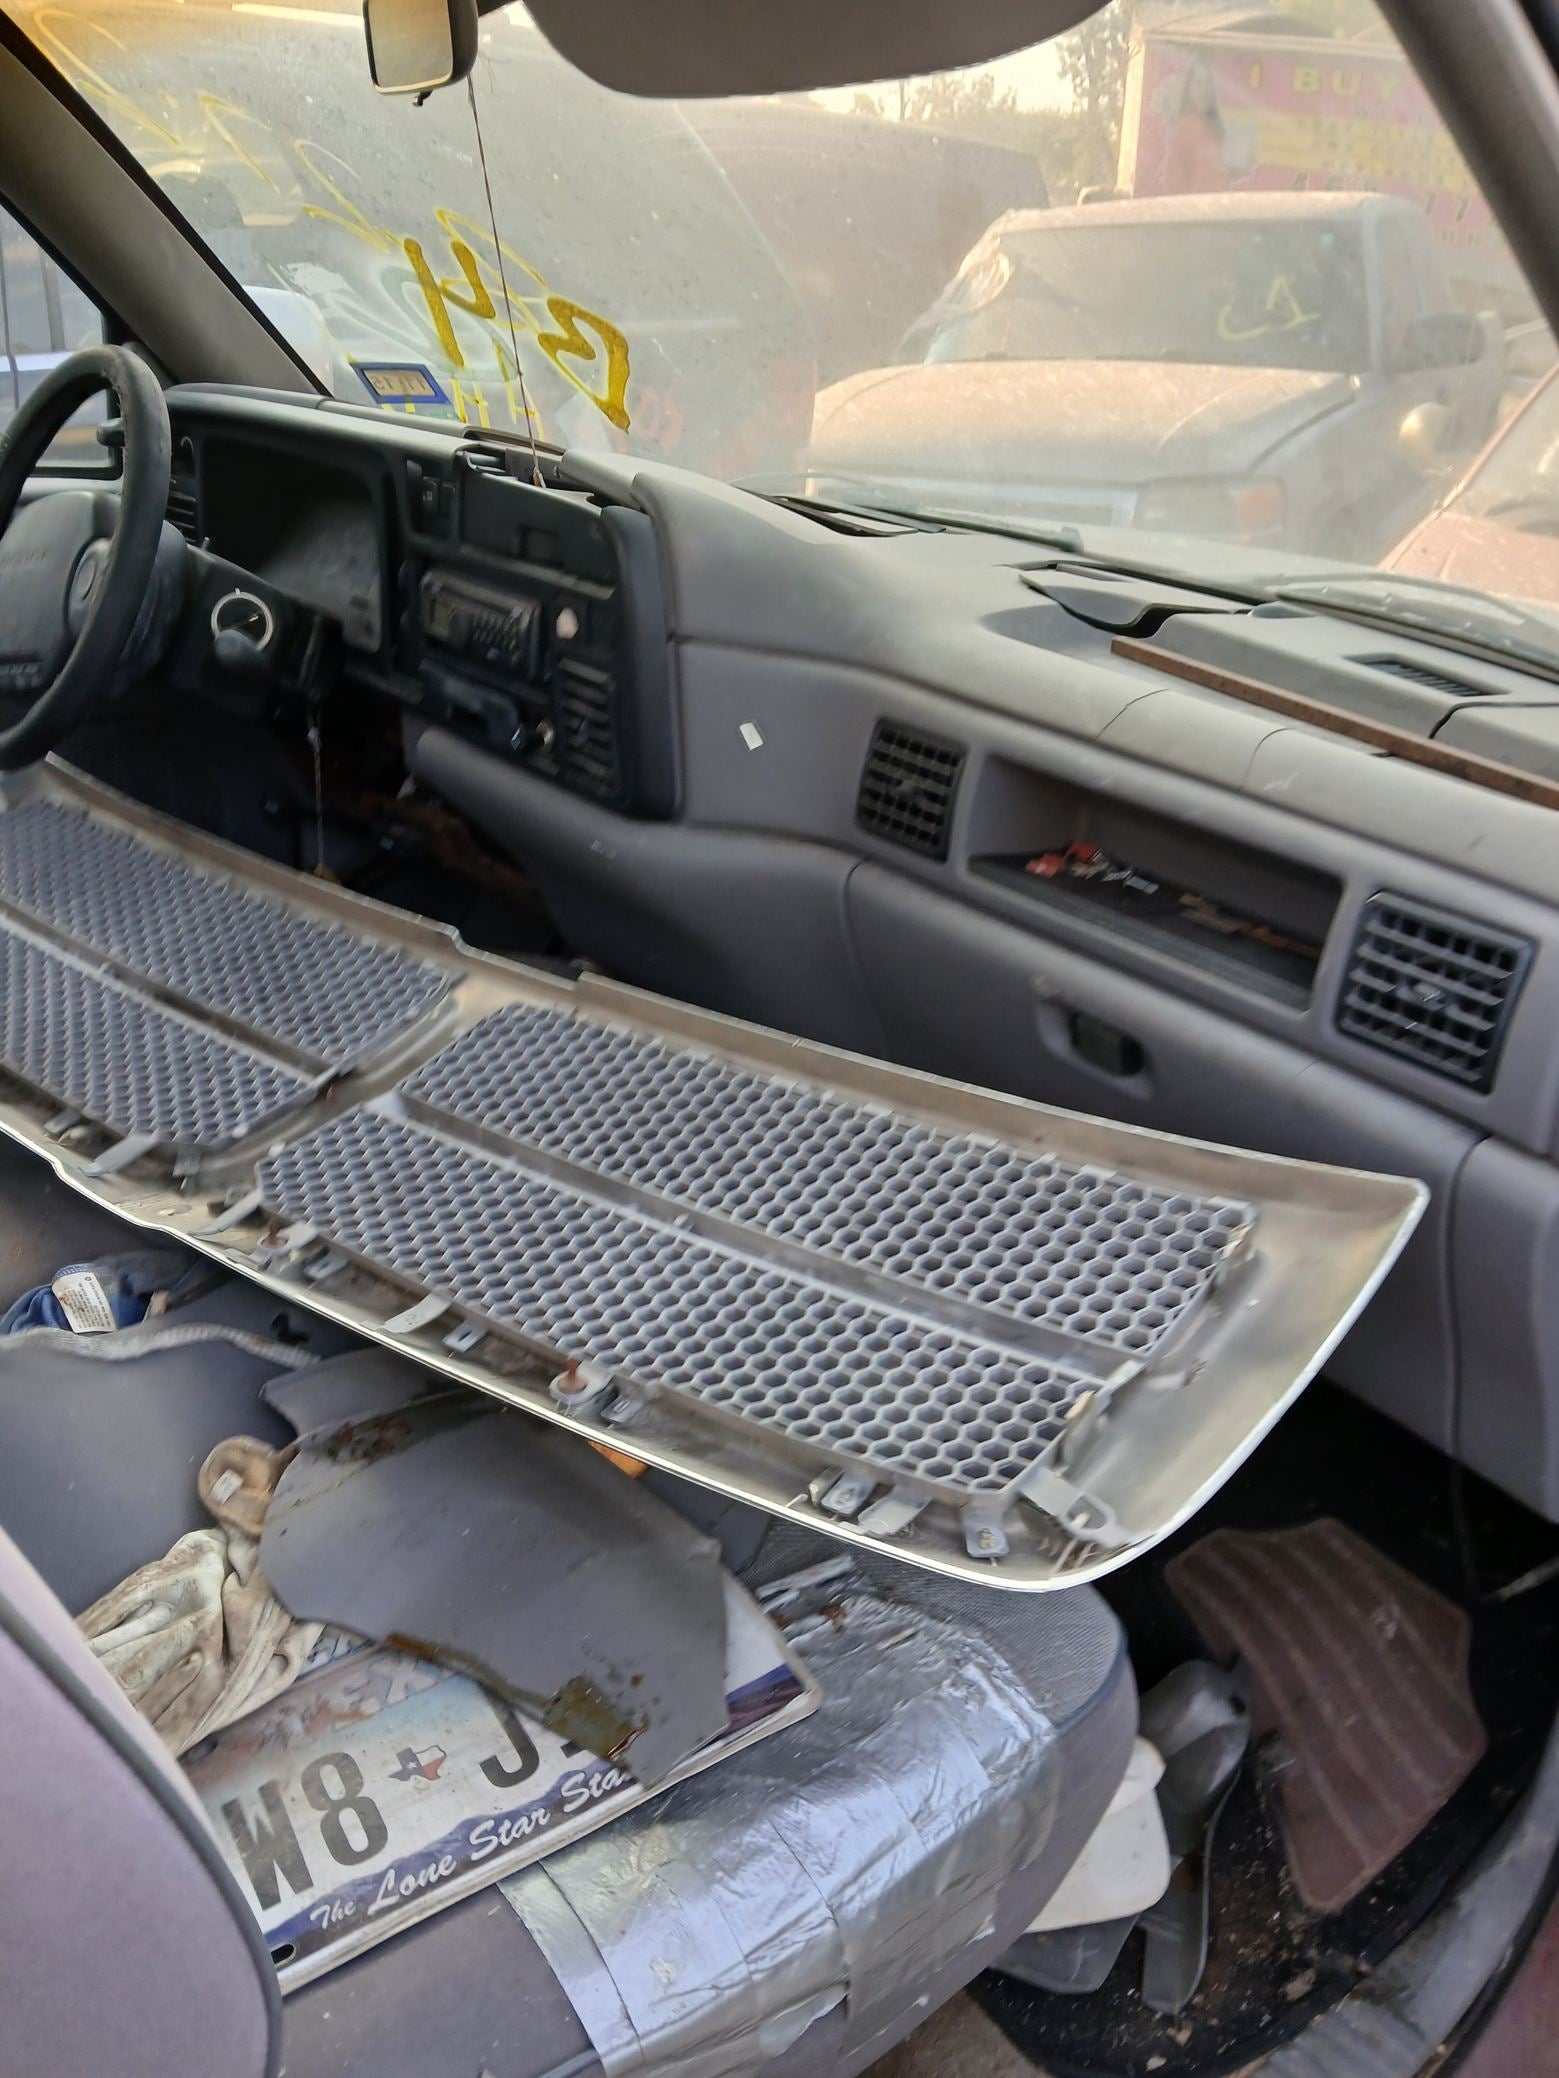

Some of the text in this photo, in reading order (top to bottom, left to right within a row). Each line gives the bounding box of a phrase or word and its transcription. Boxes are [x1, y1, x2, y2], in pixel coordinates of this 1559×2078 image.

[1293, 66, 1398, 98] BUY
[222, 1752, 389, 1911] W8
[309, 1768, 634, 1930] The Lone Star Sta
